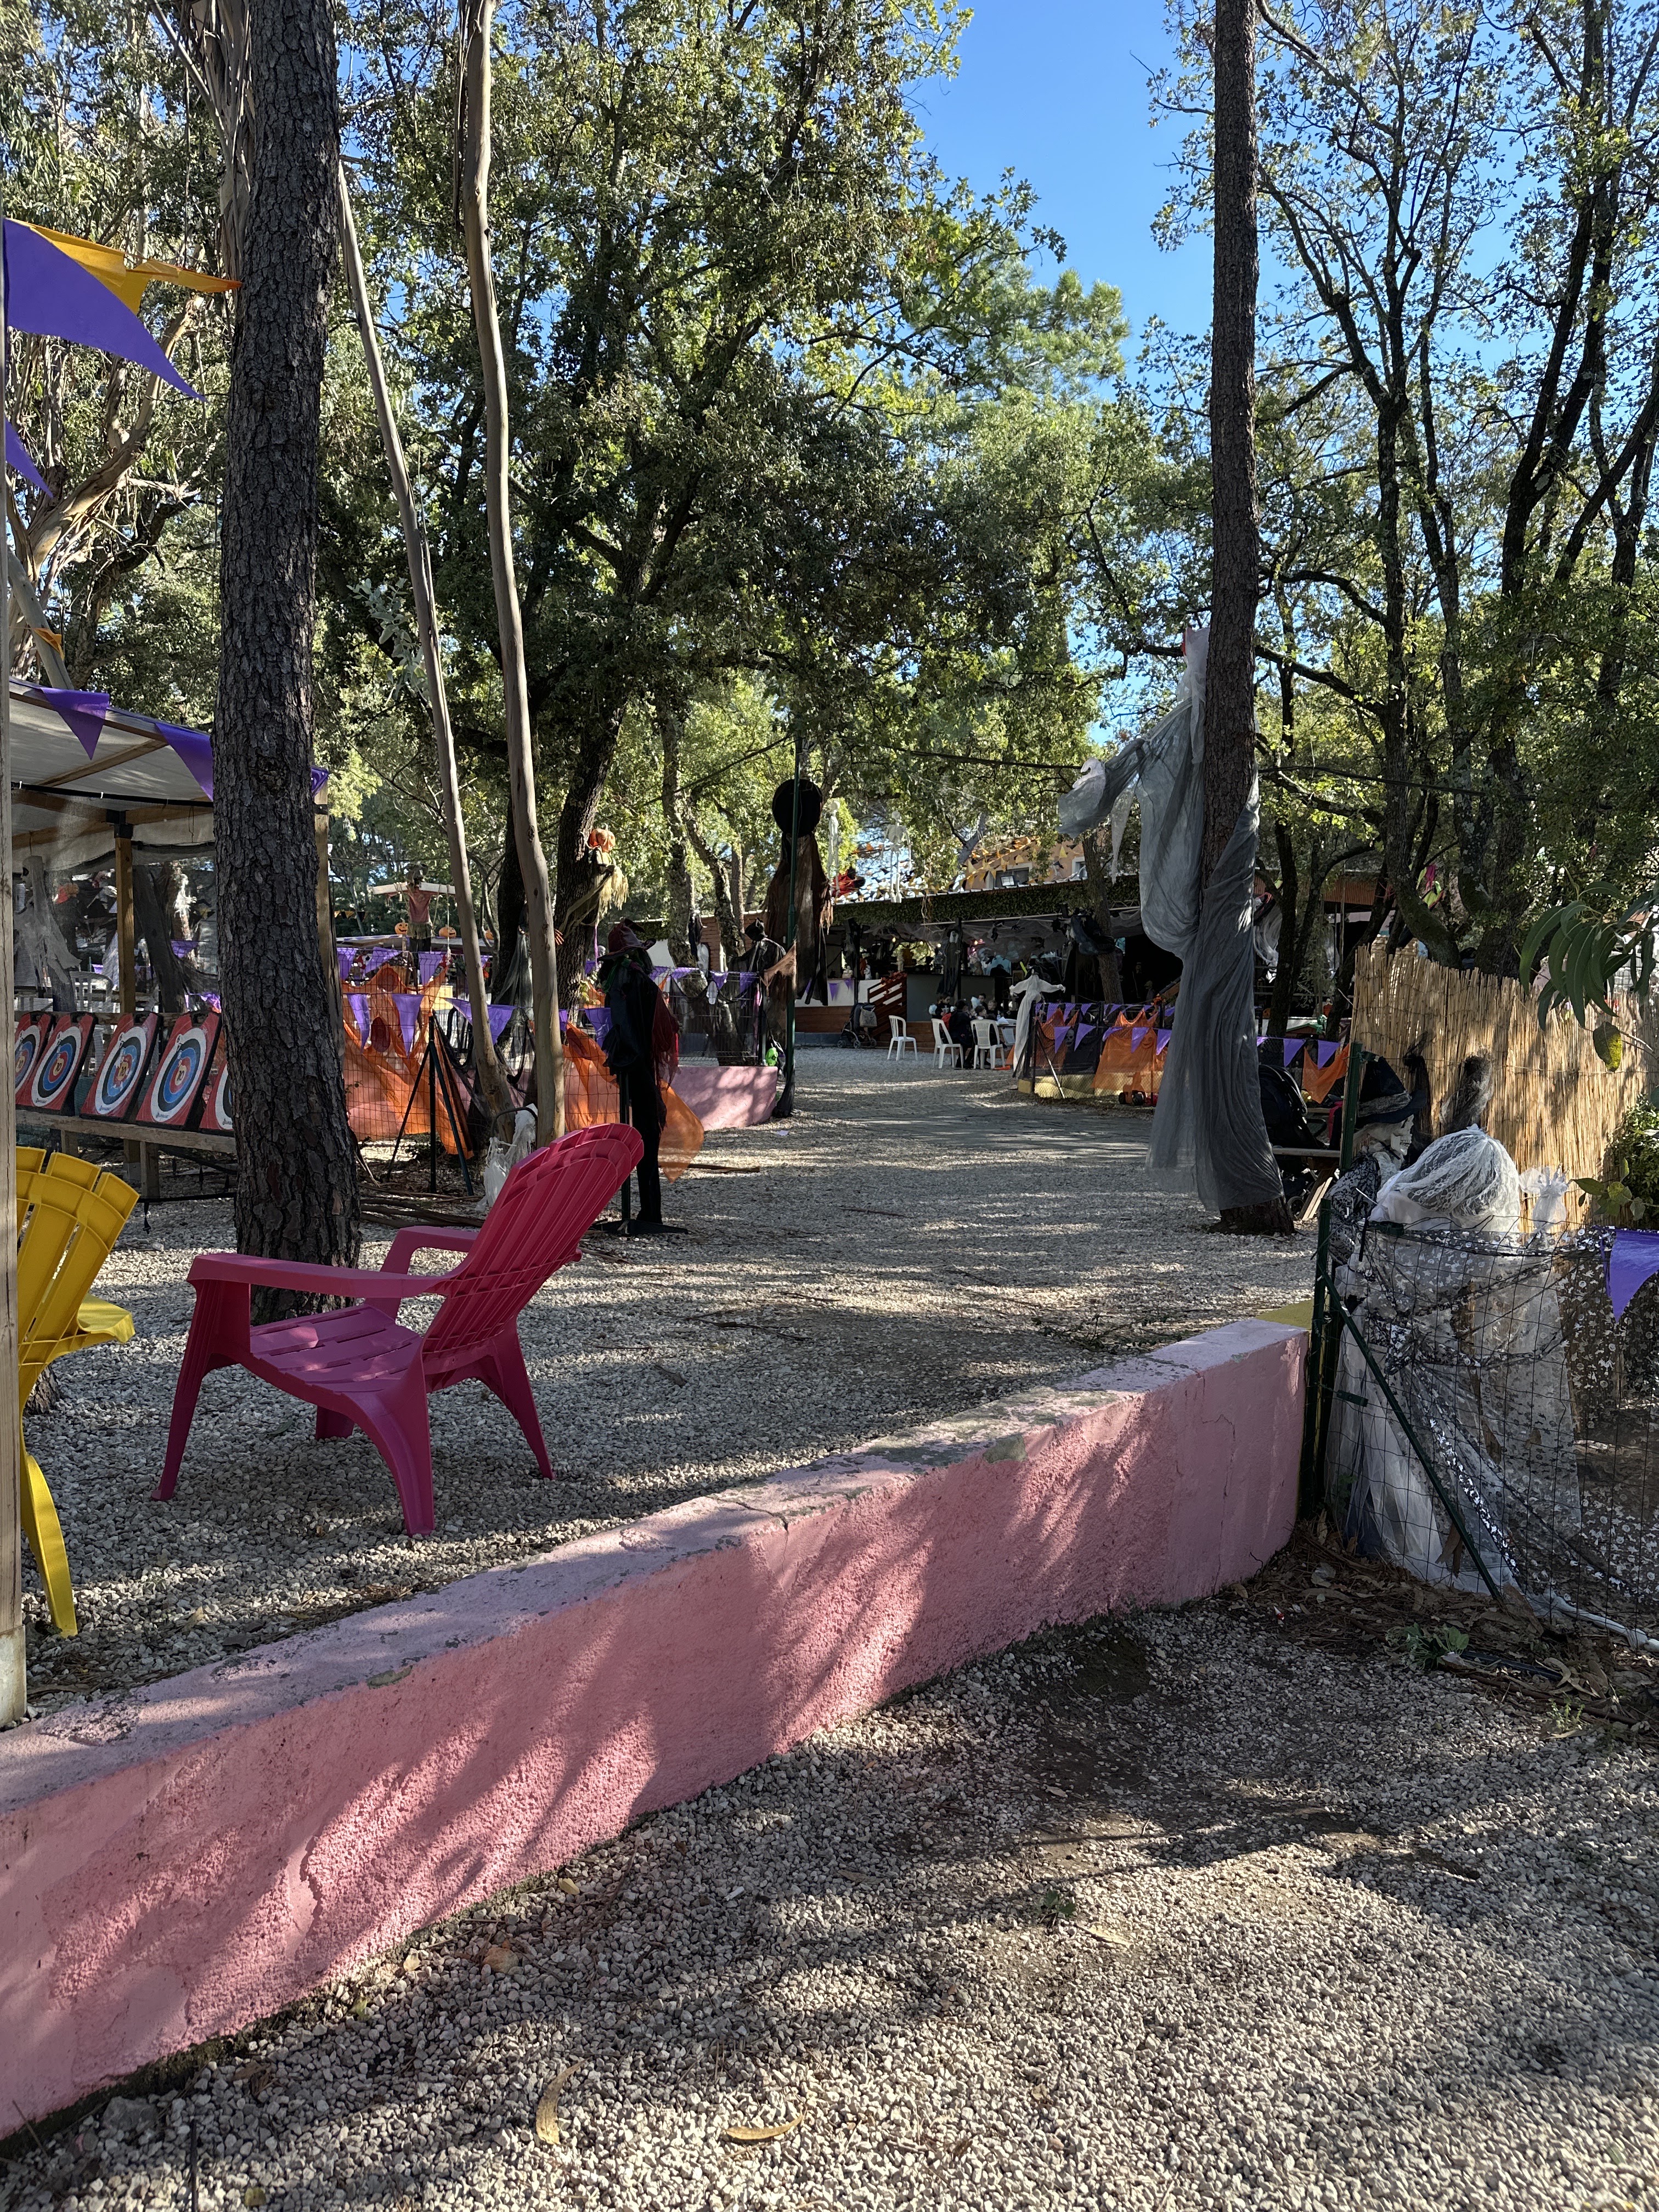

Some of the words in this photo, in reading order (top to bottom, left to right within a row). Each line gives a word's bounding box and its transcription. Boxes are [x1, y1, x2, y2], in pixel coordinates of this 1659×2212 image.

[55, 1062, 62, 1072] 10
[119, 1066, 127, 1076] 10
[177, 1070, 184, 1081] 10
